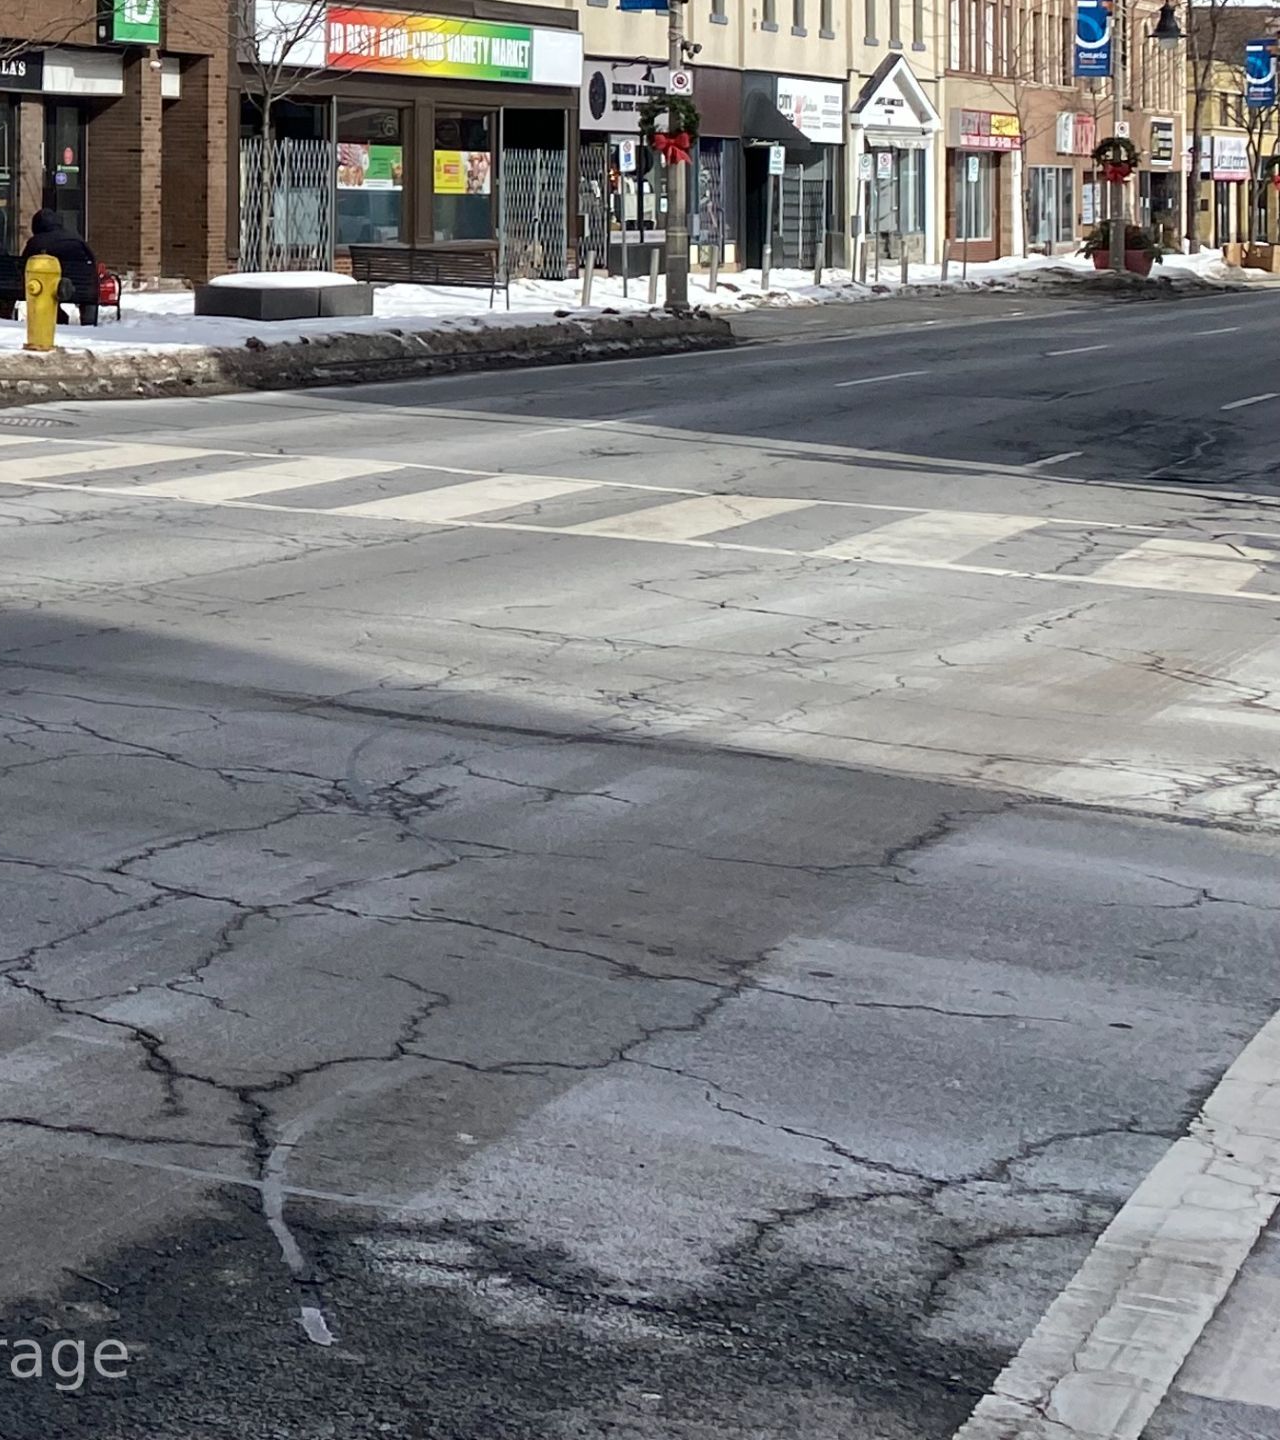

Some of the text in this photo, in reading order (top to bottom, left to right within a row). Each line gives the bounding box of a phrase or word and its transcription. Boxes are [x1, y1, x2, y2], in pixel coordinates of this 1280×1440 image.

[345, 23, 378, 57] BEST
[445, 33, 490, 65] VARIETY
[490, 37, 531, 69] MARKET
